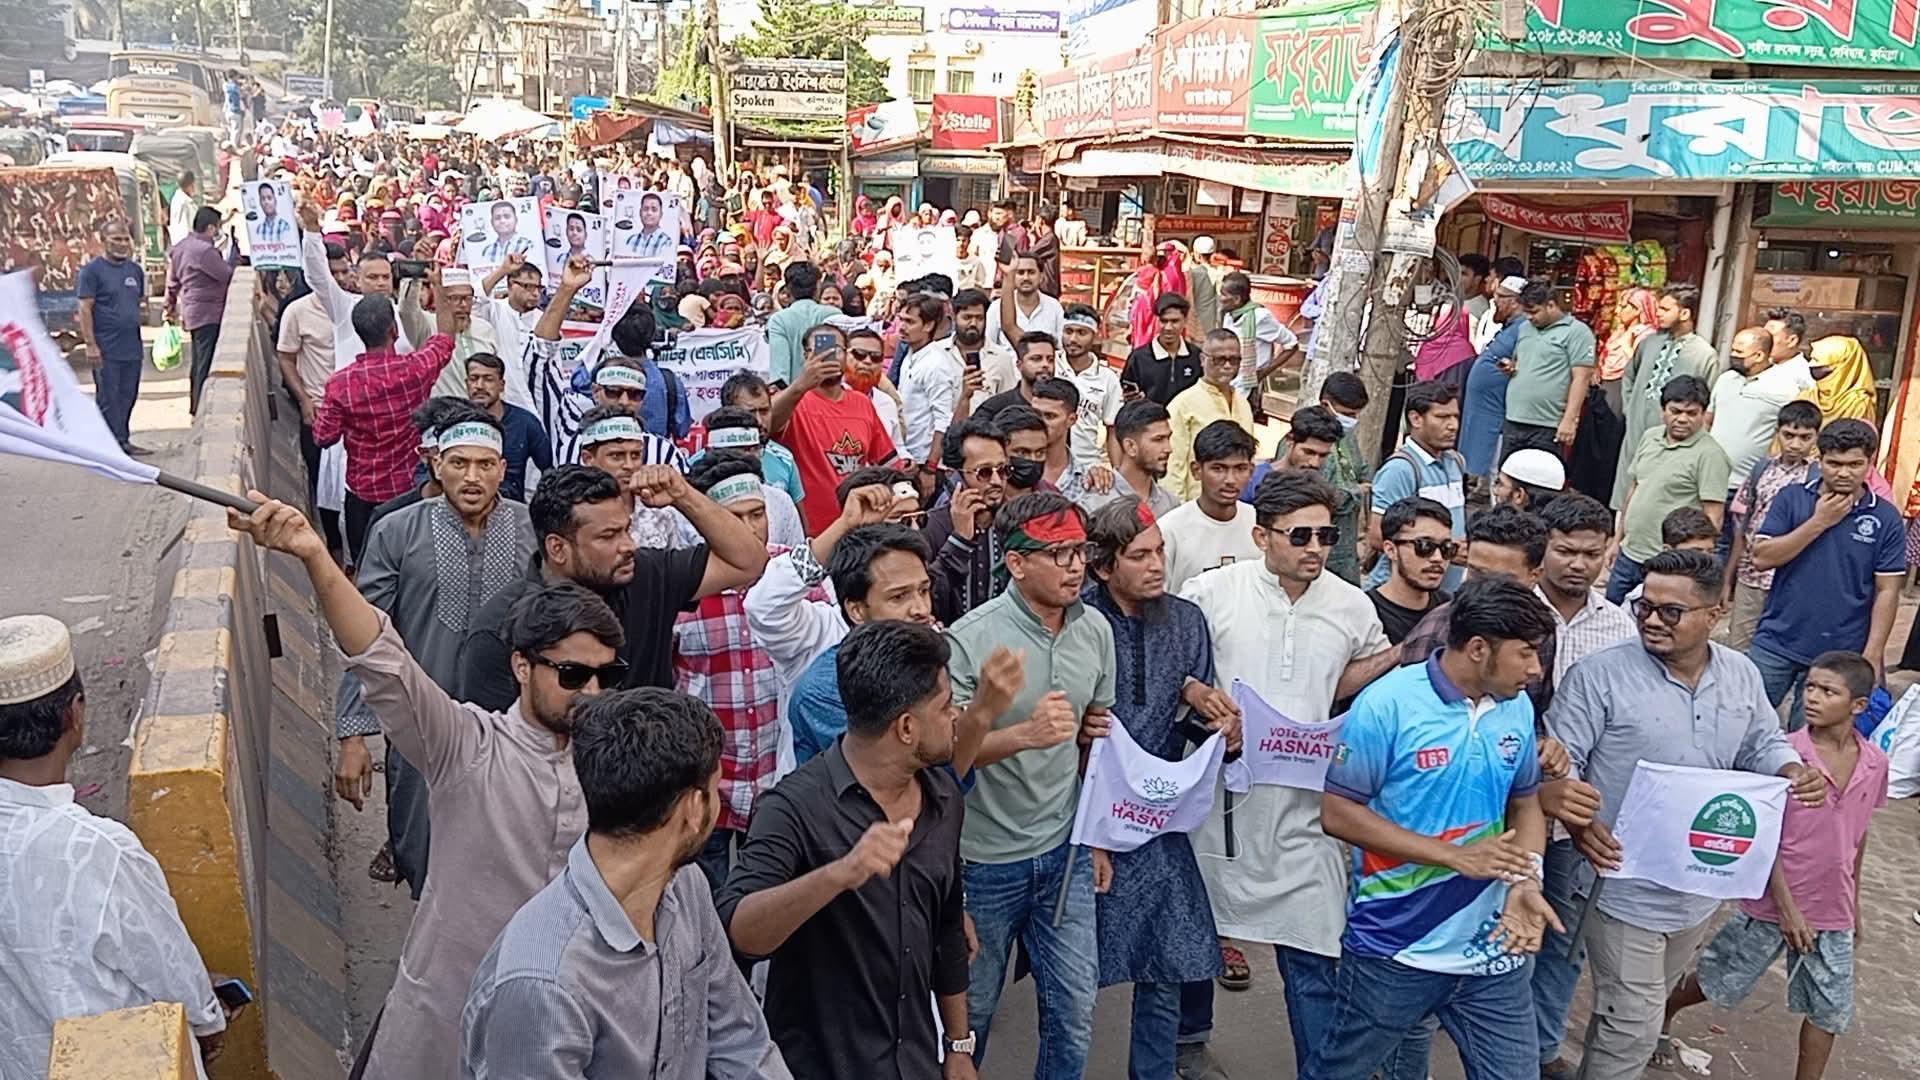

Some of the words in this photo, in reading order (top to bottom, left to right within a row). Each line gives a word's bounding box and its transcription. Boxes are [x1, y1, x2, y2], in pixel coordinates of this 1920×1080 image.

[734, 94, 775, 107] Spoken
[950, 113, 993, 130] Stella
[1588, 212, 1625, 233] আছে
[1259, 739, 1335, 759] HASNAT
[1419, 751, 1447, 768] 163
[1121, 799, 1158, 815] VOTE
[1112, 803, 1165, 829] HASN
